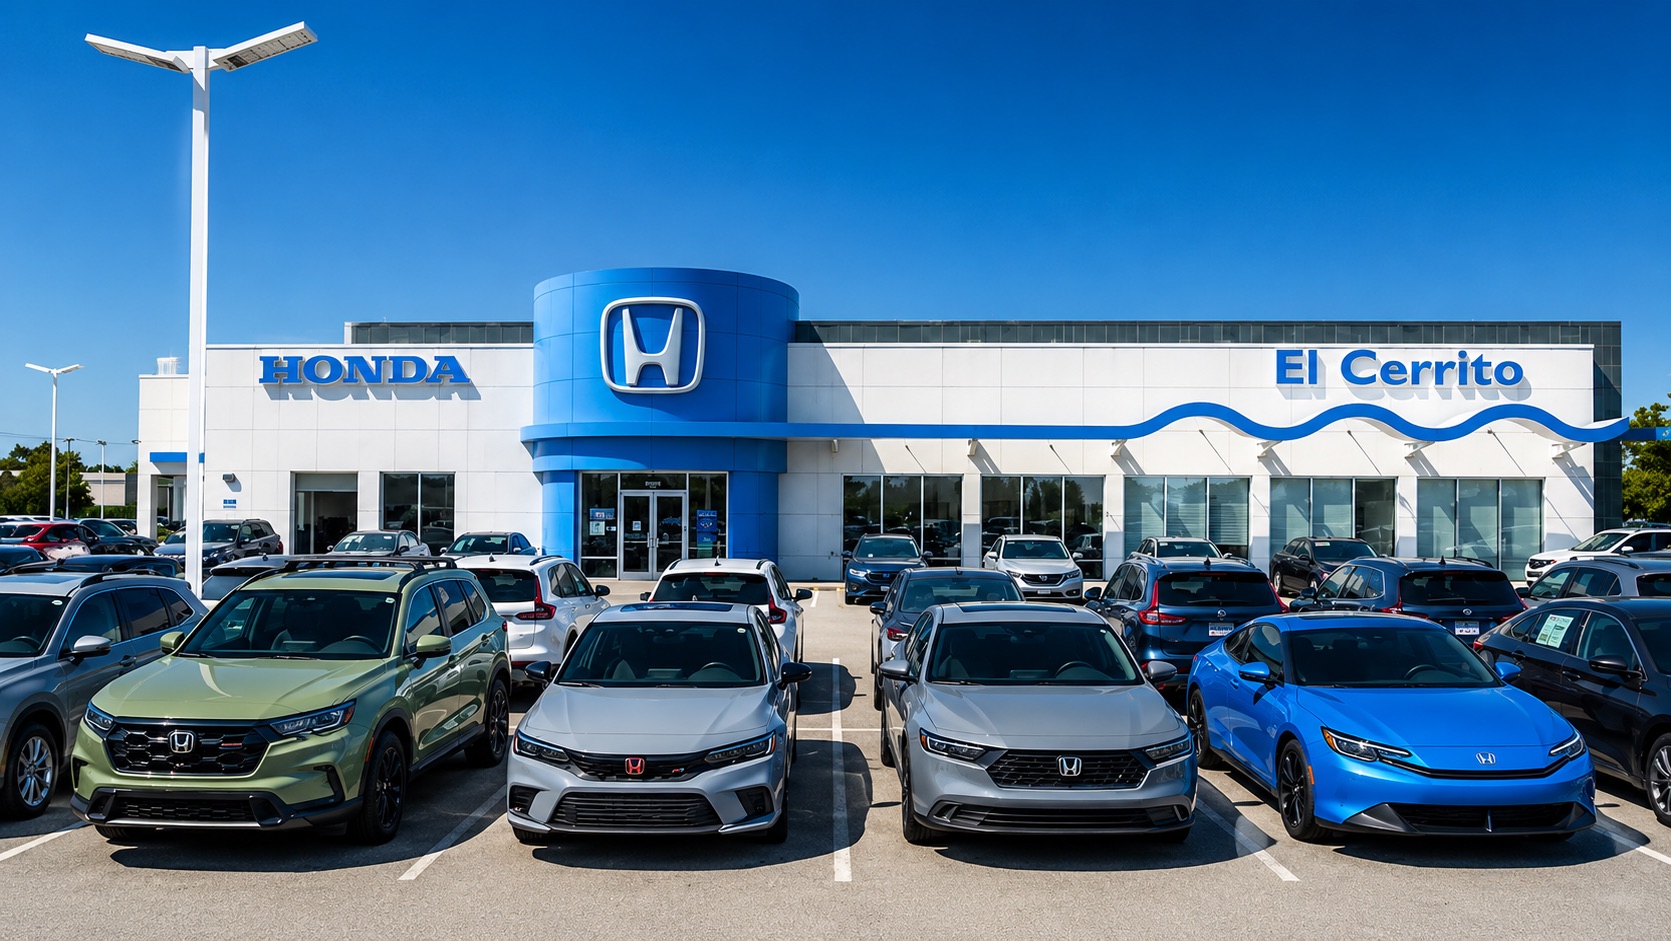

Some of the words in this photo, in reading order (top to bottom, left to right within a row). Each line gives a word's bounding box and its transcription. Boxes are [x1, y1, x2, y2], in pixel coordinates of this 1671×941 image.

[258, 355, 471, 385] HONDA
[1276, 349, 1318, 385] El
[1340, 349, 1524, 386] Cerrito
